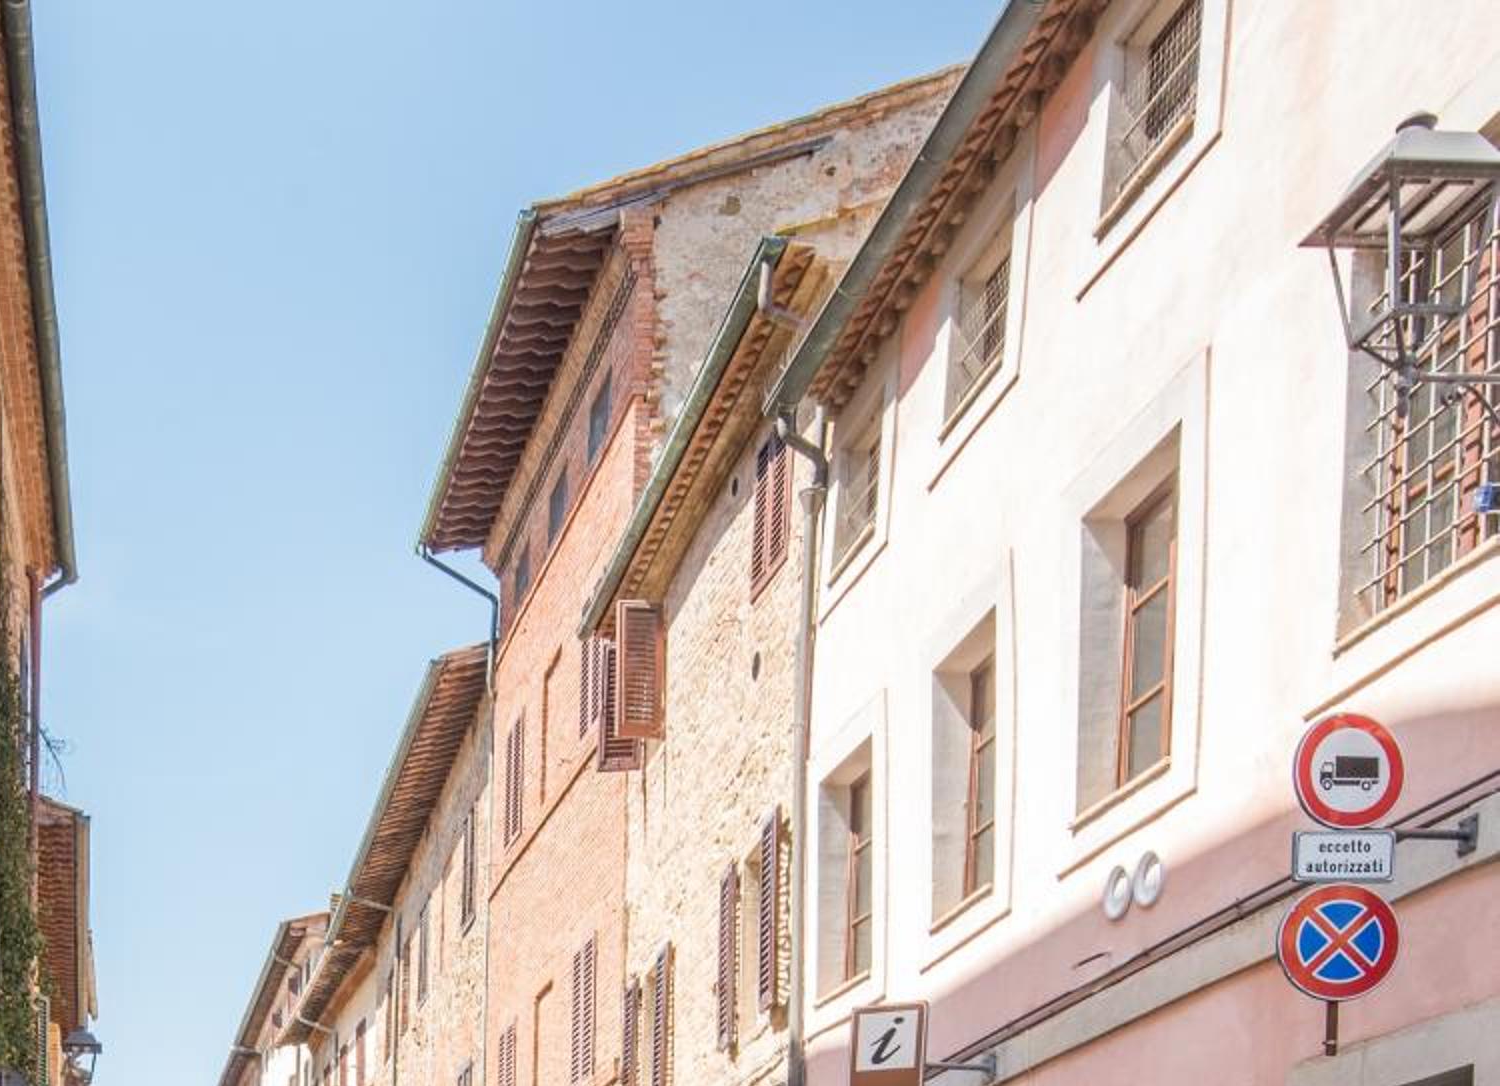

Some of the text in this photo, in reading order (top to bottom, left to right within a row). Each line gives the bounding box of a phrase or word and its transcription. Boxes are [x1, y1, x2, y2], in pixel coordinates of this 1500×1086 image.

[1319, 840, 1371, 853] eccetto
[1306, 859, 1384, 873] autorizzati
[870, 1016, 905, 1065] i
